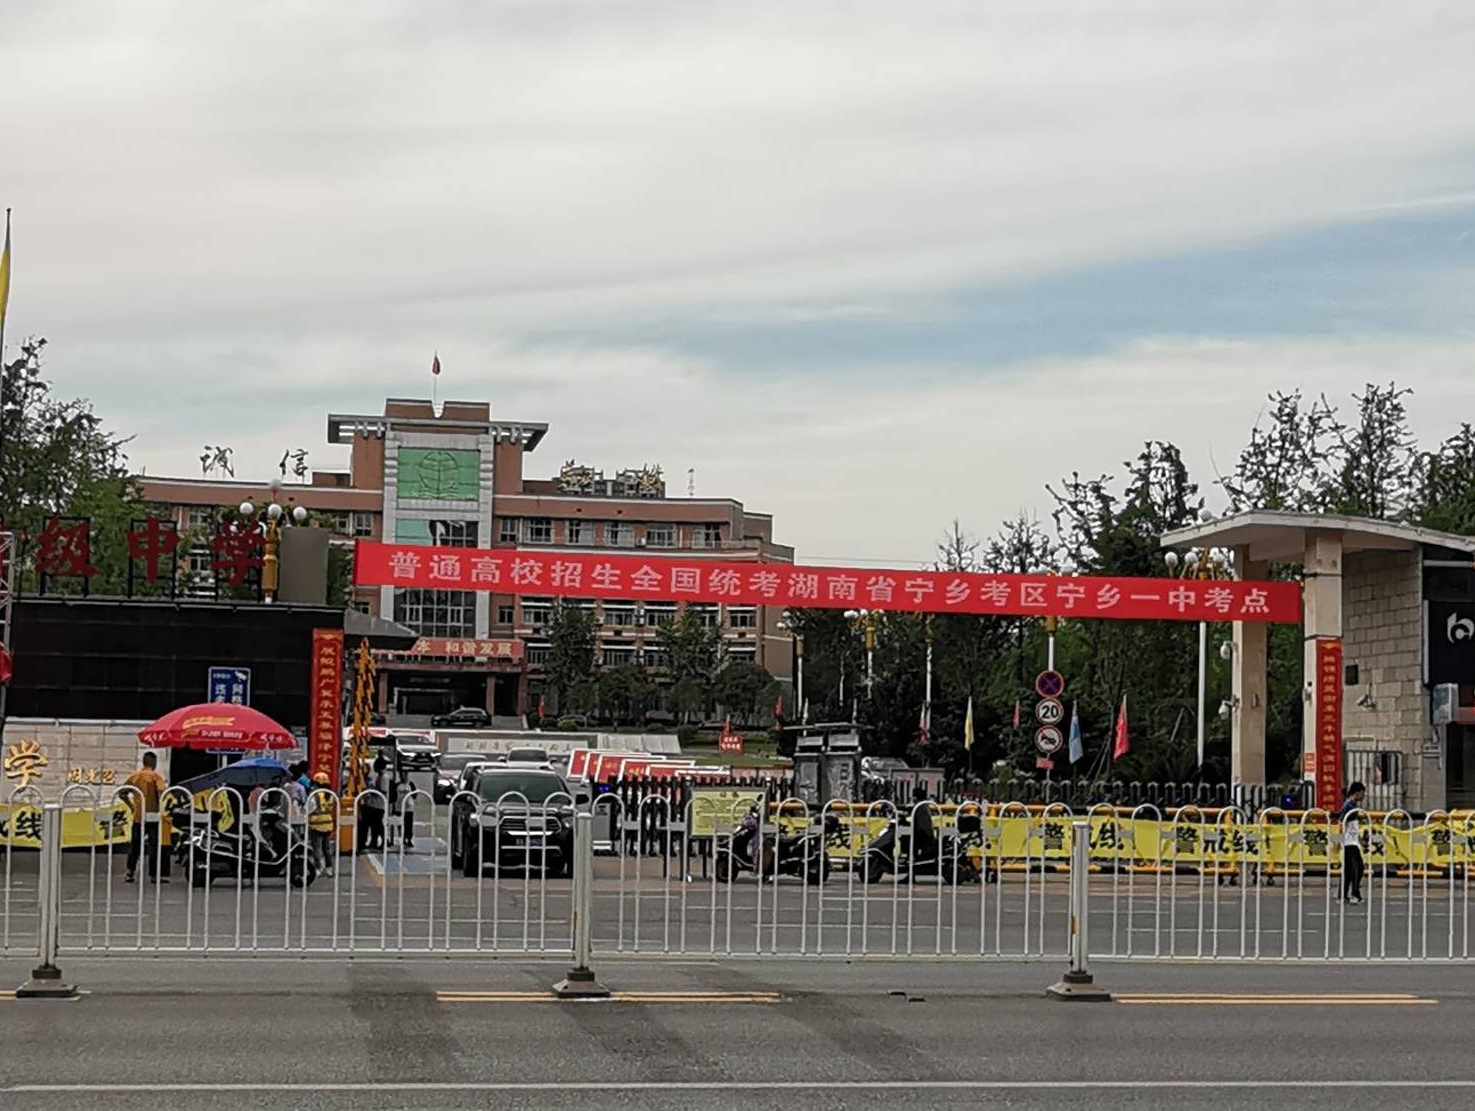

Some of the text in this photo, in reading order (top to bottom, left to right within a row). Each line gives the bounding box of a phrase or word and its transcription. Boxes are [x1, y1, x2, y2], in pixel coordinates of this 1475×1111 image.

[388, 550, 1271, 615] 普通高校招生全国统考湖南省宁乡考区宁乡一中考点
[445, 641, 512, 656] 和谐发展
[1041, 705, 1059, 719] 20
